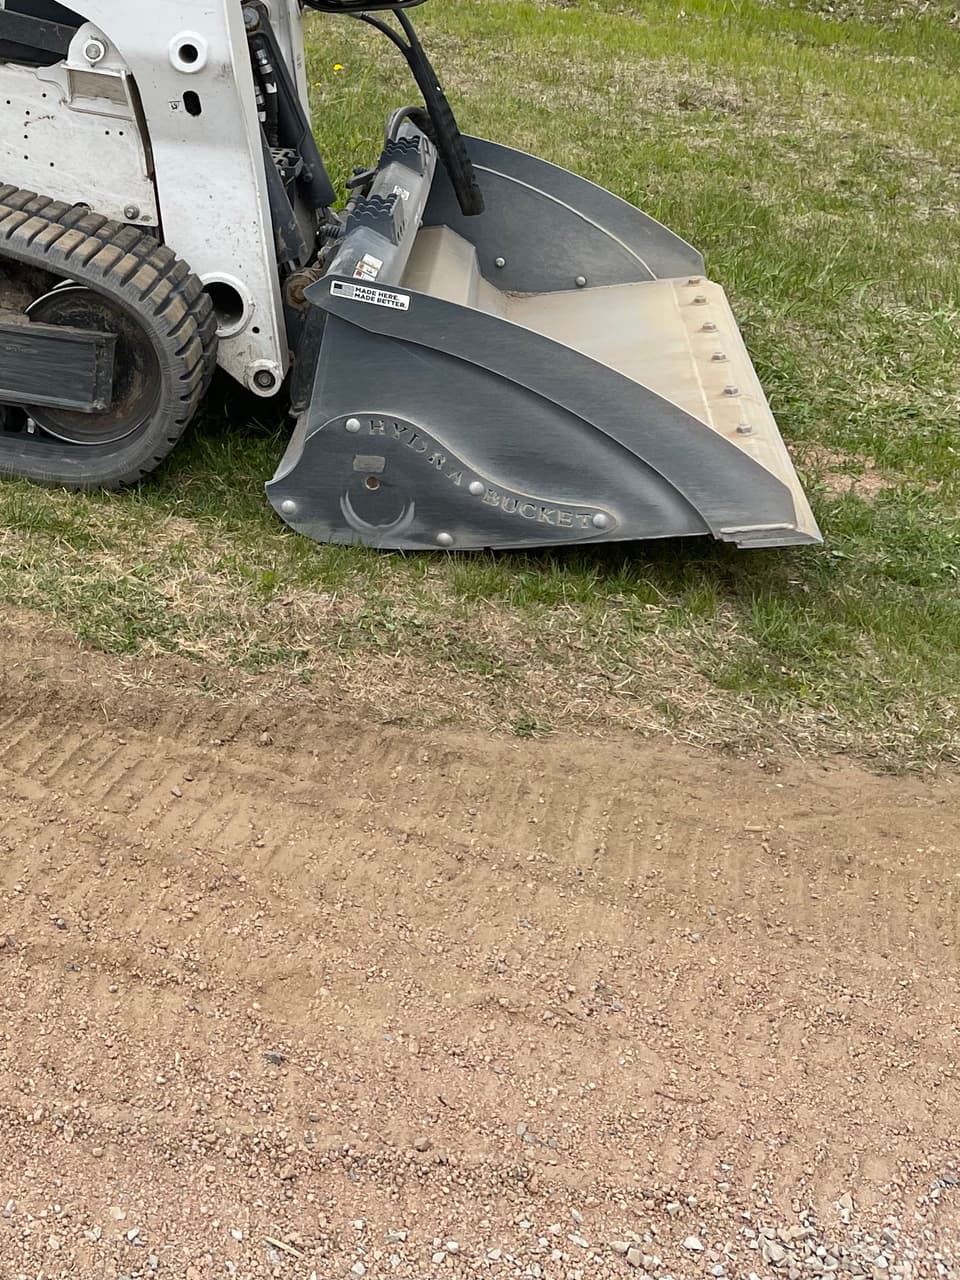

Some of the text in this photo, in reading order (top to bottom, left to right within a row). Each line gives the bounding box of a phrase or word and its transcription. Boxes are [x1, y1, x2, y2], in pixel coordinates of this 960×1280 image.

[355, 287, 377, 297] MADE
[354, 293, 407, 309] MADE BETTER.
[368, 419, 593, 529] HYDRA BUCKET
